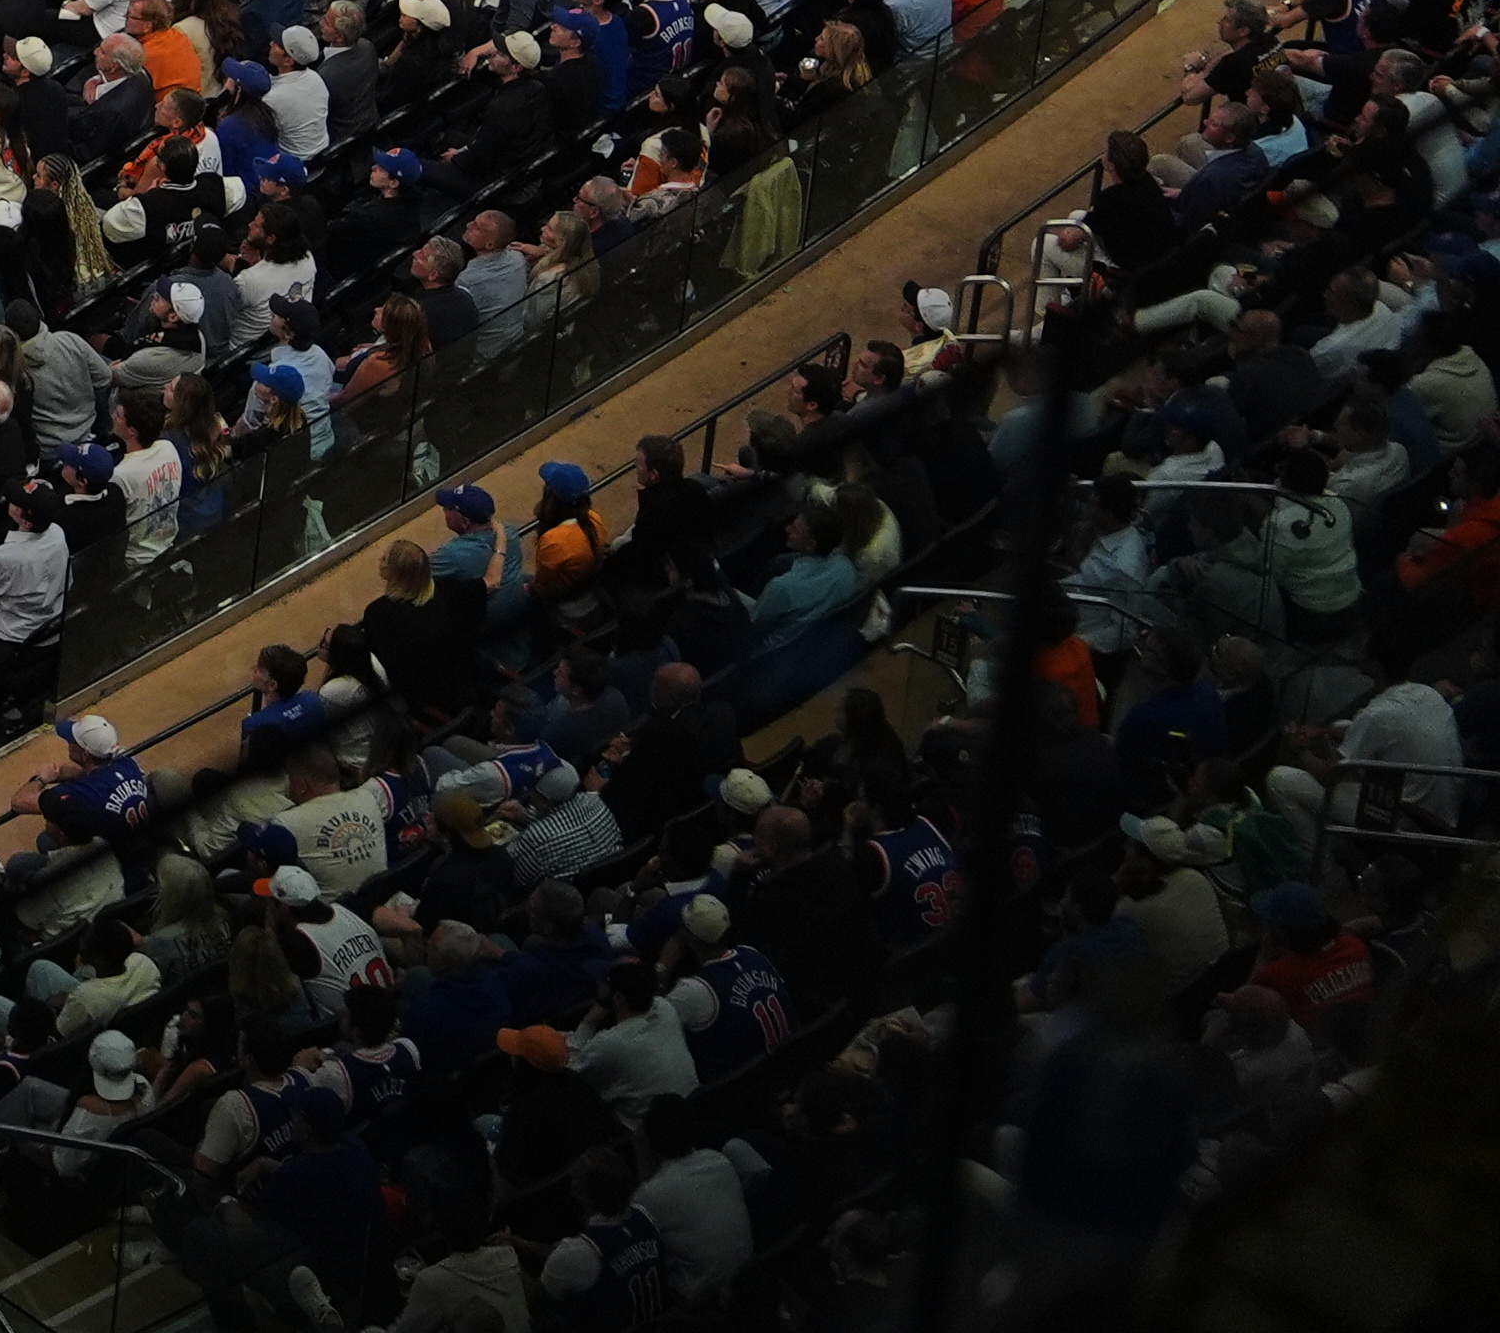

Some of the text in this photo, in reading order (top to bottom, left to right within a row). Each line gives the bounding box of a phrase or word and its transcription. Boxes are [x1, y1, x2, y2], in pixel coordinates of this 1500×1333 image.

[332, 935, 377, 974] FRAZIER
[732, 967, 780, 1011] BRUNSON
[752, 996, 788, 1049] 11
